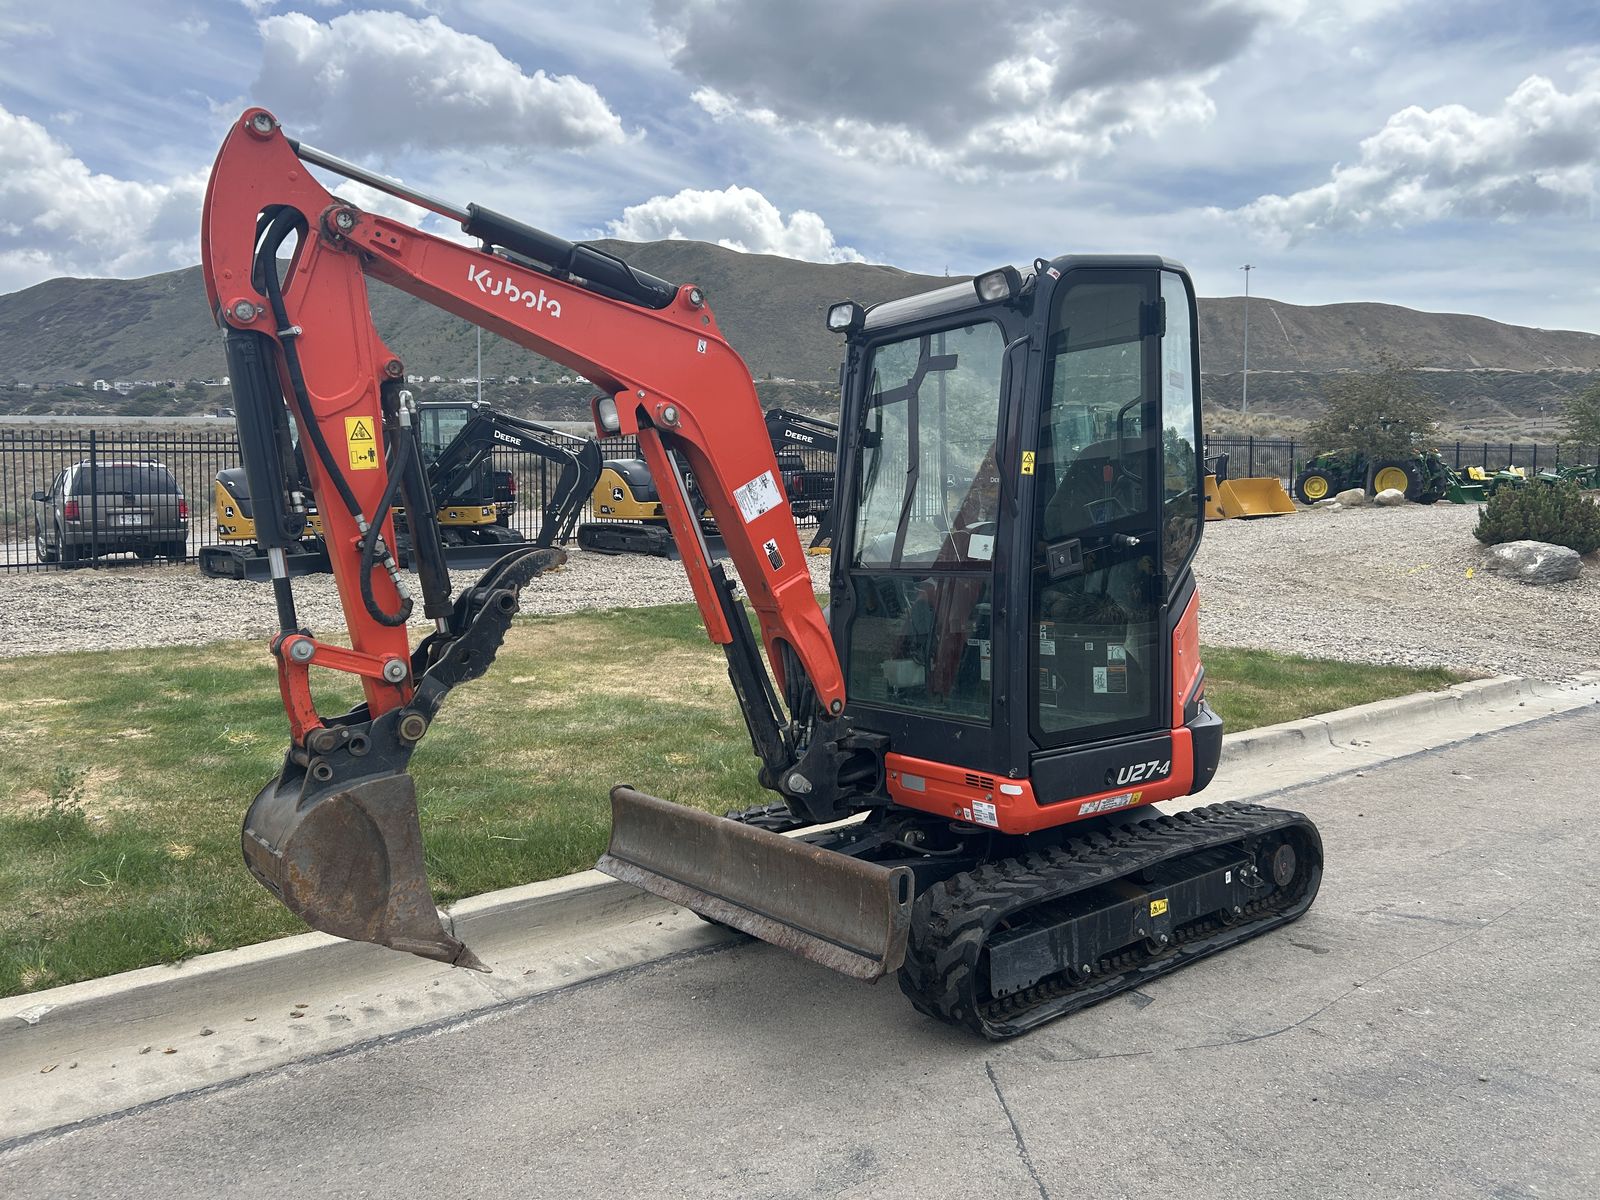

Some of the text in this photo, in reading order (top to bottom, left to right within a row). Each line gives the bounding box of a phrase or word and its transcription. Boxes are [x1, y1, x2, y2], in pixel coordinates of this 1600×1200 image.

[467, 263, 562, 319] Kubota
[493, 429, 522, 446] DEERE
[784, 429, 814, 444] DEERE
[1116, 759, 1171, 785] U27-4
